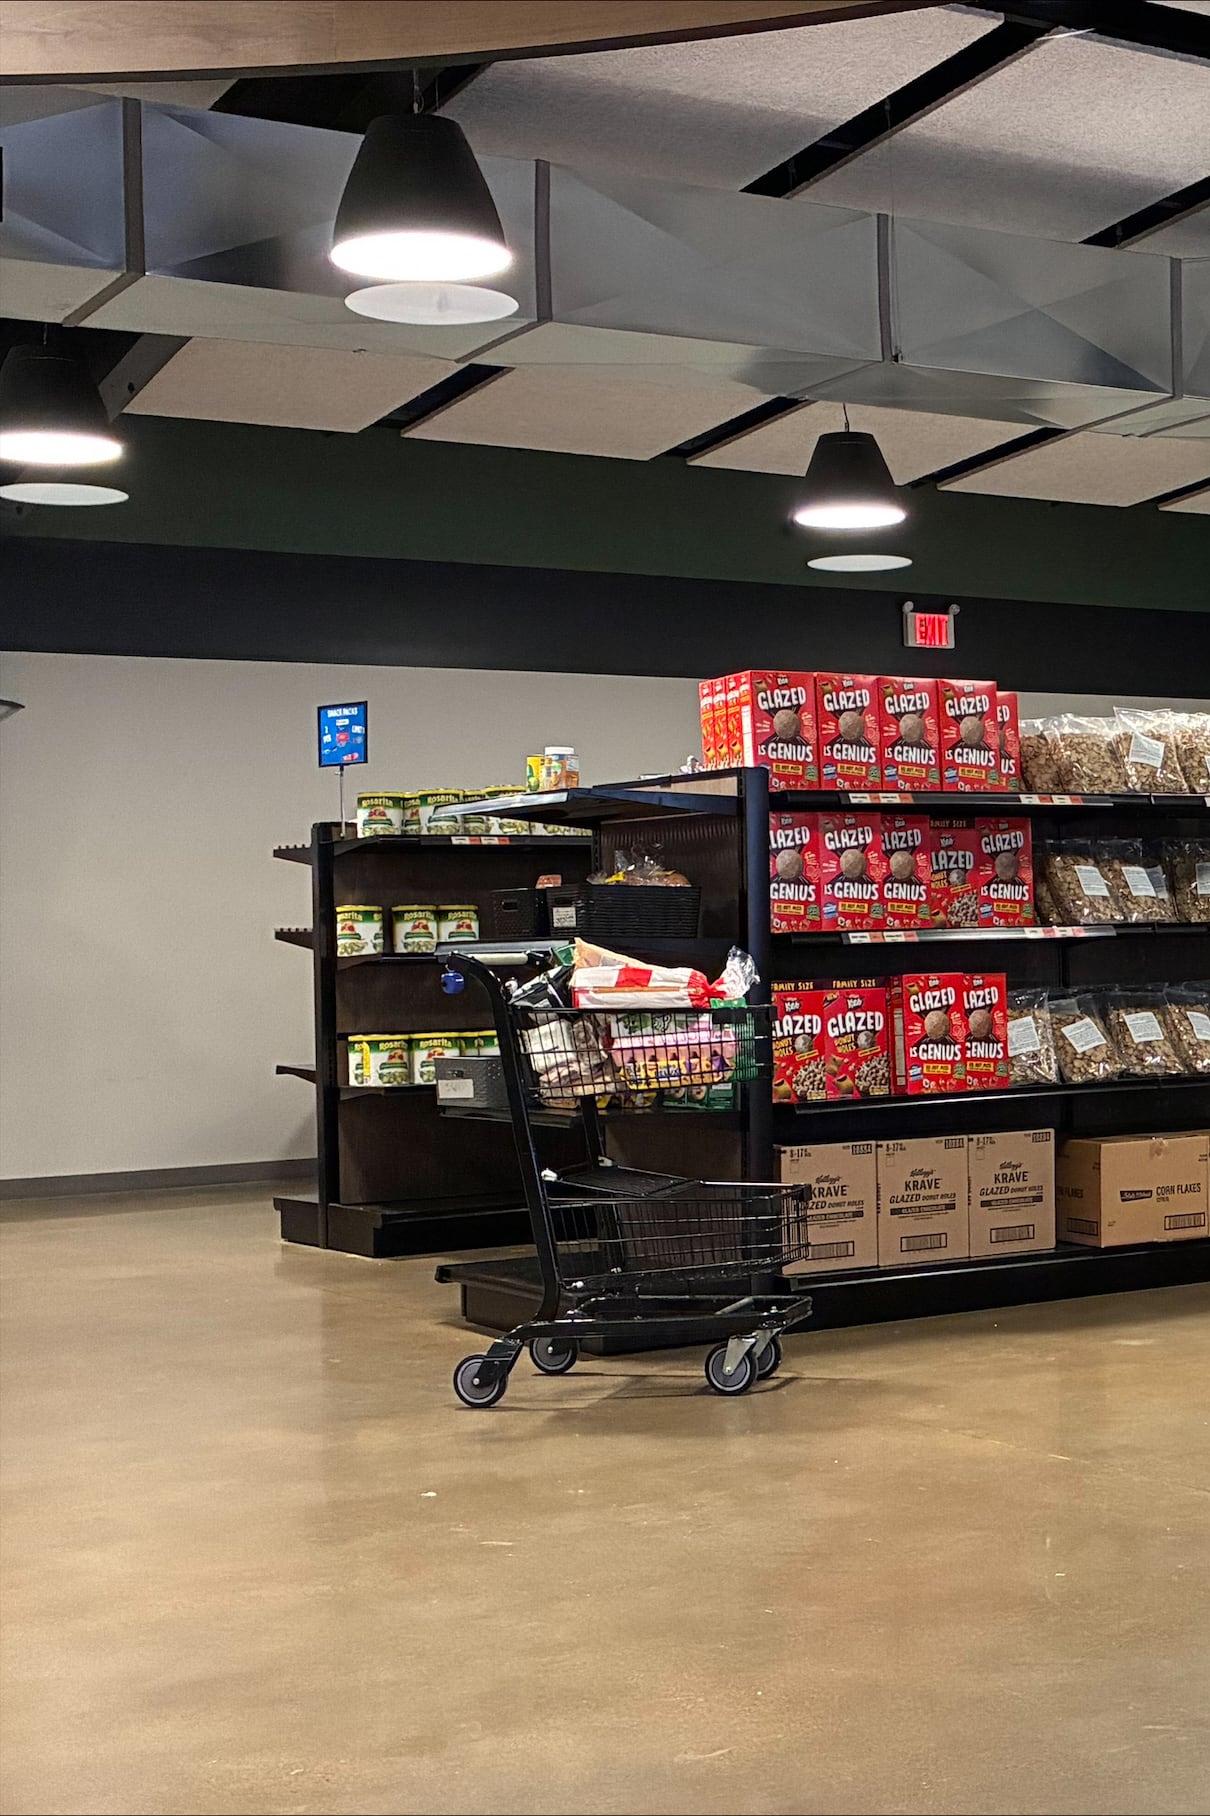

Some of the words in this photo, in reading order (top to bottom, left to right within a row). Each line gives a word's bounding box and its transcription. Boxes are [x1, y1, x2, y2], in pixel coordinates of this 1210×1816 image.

[915, 614, 949, 646] EXIT
[757, 686, 806, 710] GLAZED
[823, 689, 870, 712] GLAZED
[885, 692, 930, 714] GLAZED
[945, 694, 990, 717] GLAZED
[758, 745, 766, 756] IS
[768, 743, 813, 762] GENIUS
[823, 745, 831, 757] IS
[833, 743, 876, 763] GENIUS
[885, 747, 892, 758] IS
[894, 746, 936, 765] GENIUS
[945, 750, 953, 760] IS
[954, 748, 995, 767] GENIUS
[769, 826, 810, 849] LAZED
[824, 826, 873, 850] GLAZED
[981, 831, 1024, 854] GLAZED
[931, 850, 974, 871] LAZED
[769, 882, 816, 901] GENIUS
[824, 884, 832, 895] IS
[834, 882, 879, 900] GENIUS
[884, 883, 927, 901] GENIUS
[989, 884, 1029, 901] GENIUS
[909, 986, 956, 1013] GLAZED
[963, 986, 999, 1009] LAZED
[827, 1011, 884, 1038] GLAZED
[910, 1047, 918, 1058] IS
[919, 1043, 962, 1061] GENIUS
[904, 1178, 941, 1192] KRAVE
[994, 1171, 1029, 1184] KRAVE
[889, 1193, 921, 1204] GLAZED
[979, 1186, 1010, 1197] GLAZED
[1156, 1185, 1175, 1197] CORN
[1176, 1182, 1201, 1194] FLAKES
